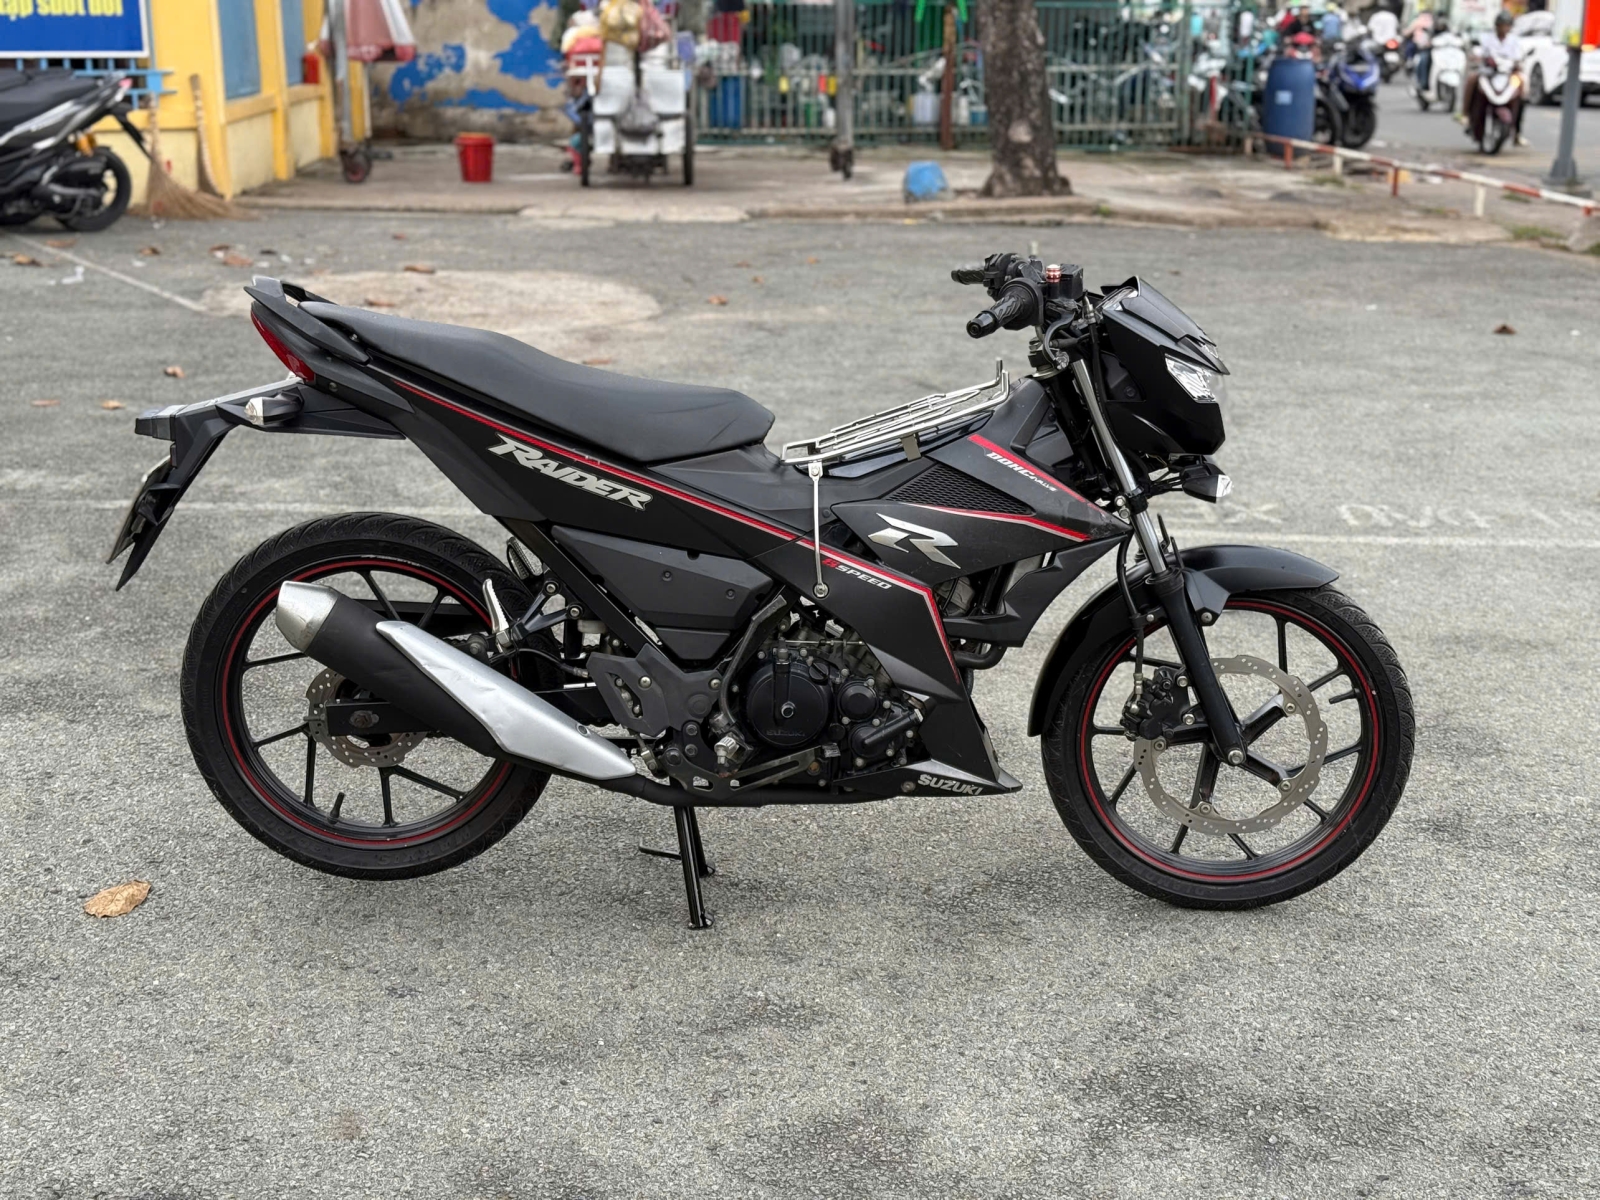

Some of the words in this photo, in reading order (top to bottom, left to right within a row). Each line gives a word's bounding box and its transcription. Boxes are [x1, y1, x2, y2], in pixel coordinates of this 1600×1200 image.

[488, 433, 653, 510] RAIDER
[986, 451, 1035, 477] DOHC
[917, 773, 984, 796] SUZUKI
